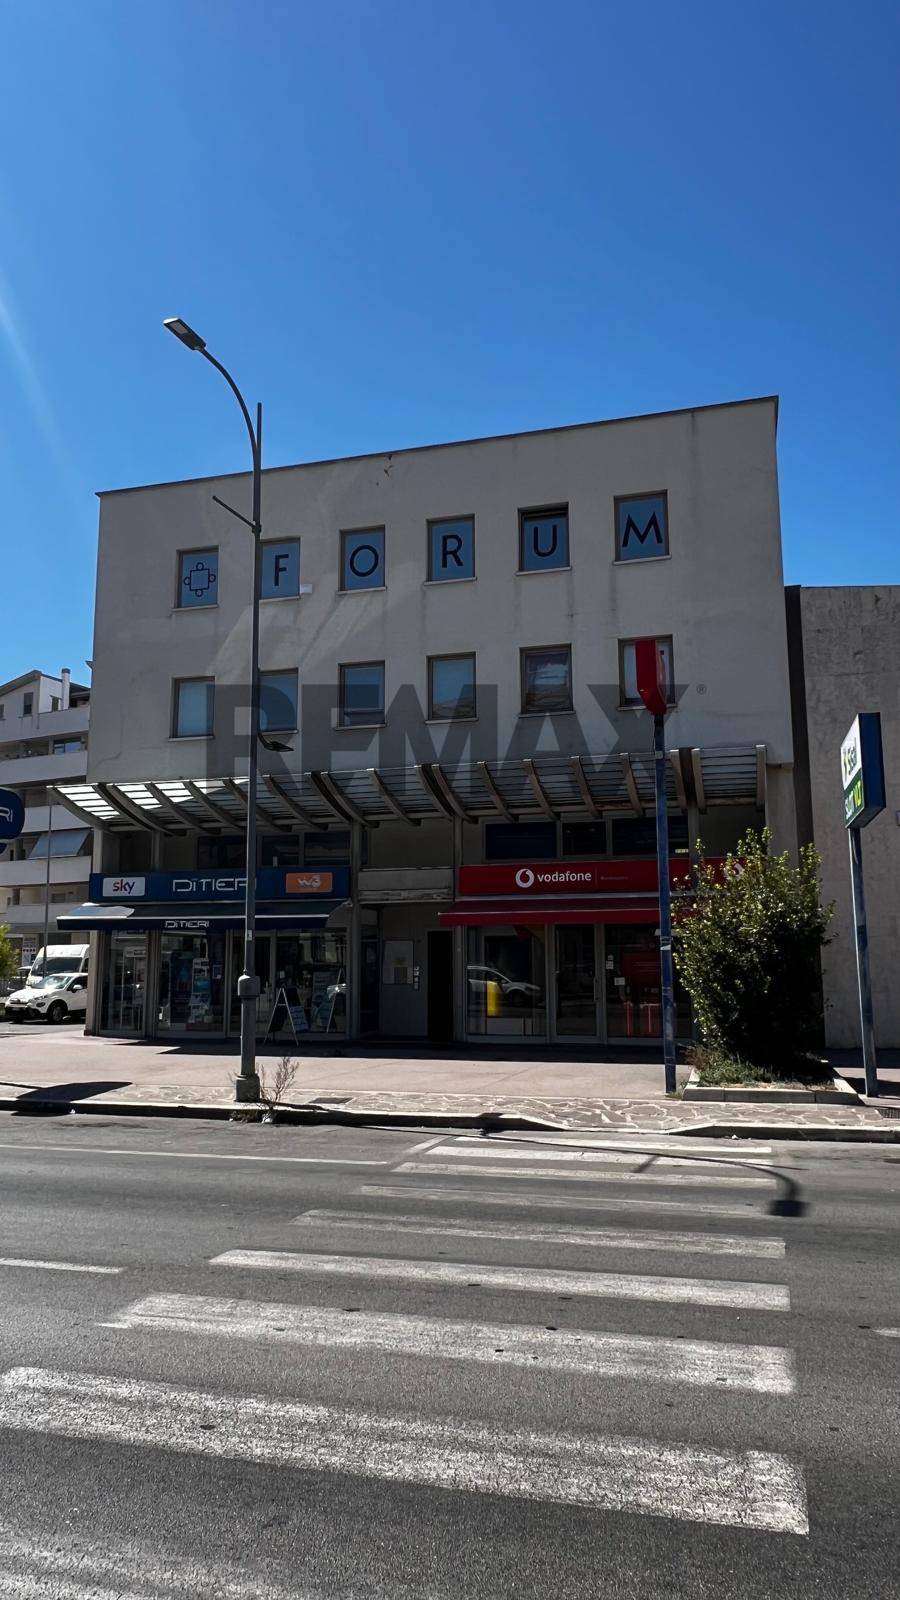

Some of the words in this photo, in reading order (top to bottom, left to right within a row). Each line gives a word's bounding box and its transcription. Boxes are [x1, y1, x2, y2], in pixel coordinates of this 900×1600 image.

[275, 511, 664, 587] FORUM
[537, 870, 592, 883] vodafone
[112, 879, 135, 894] sky
